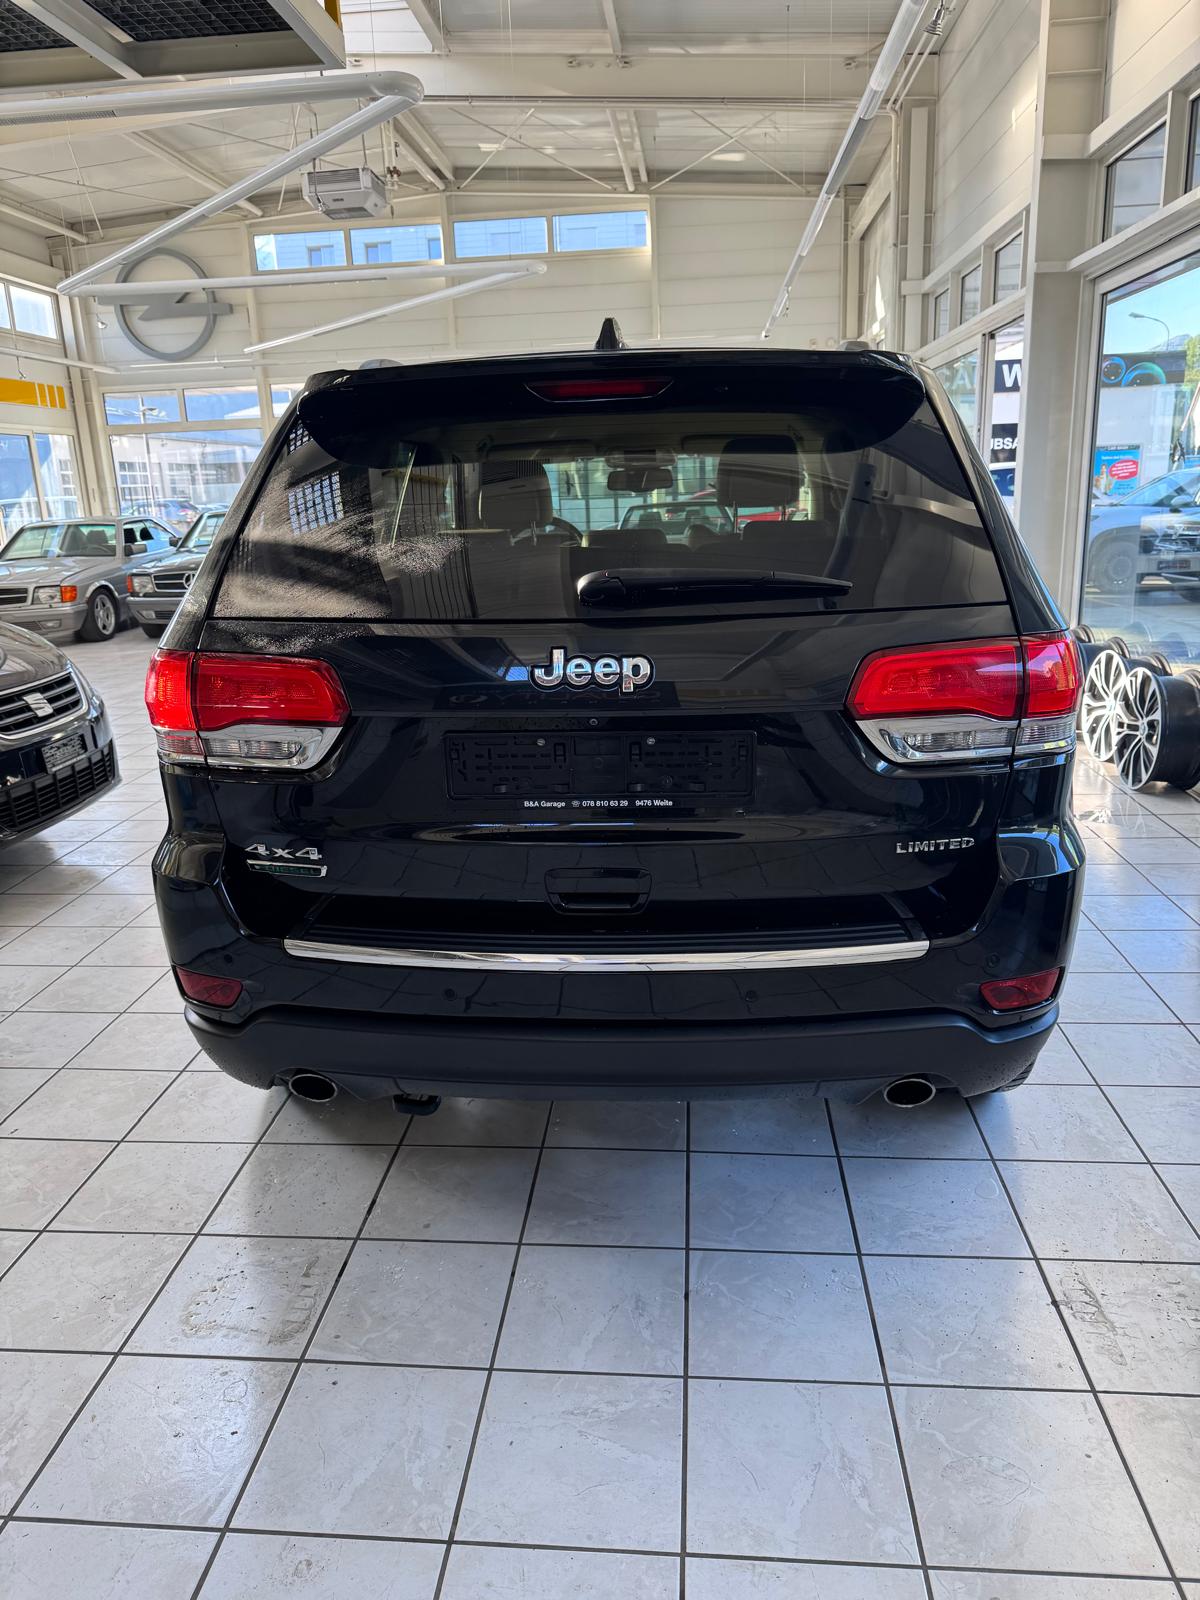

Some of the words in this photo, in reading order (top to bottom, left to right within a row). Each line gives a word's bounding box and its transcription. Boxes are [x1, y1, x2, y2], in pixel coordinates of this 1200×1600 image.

[534, 648, 651, 692] Jeep
[524, 800, 539, 808] B&A
[540, 800, 566, 809] Garage
[582, 799, 595, 807] 078
[596, 799, 609, 807] 810
[610, 799, 619, 807] 63
[620, 799, 629, 807] 29
[635, 799, 652, 807] 9476
[896, 837, 975, 854] LIMITED
